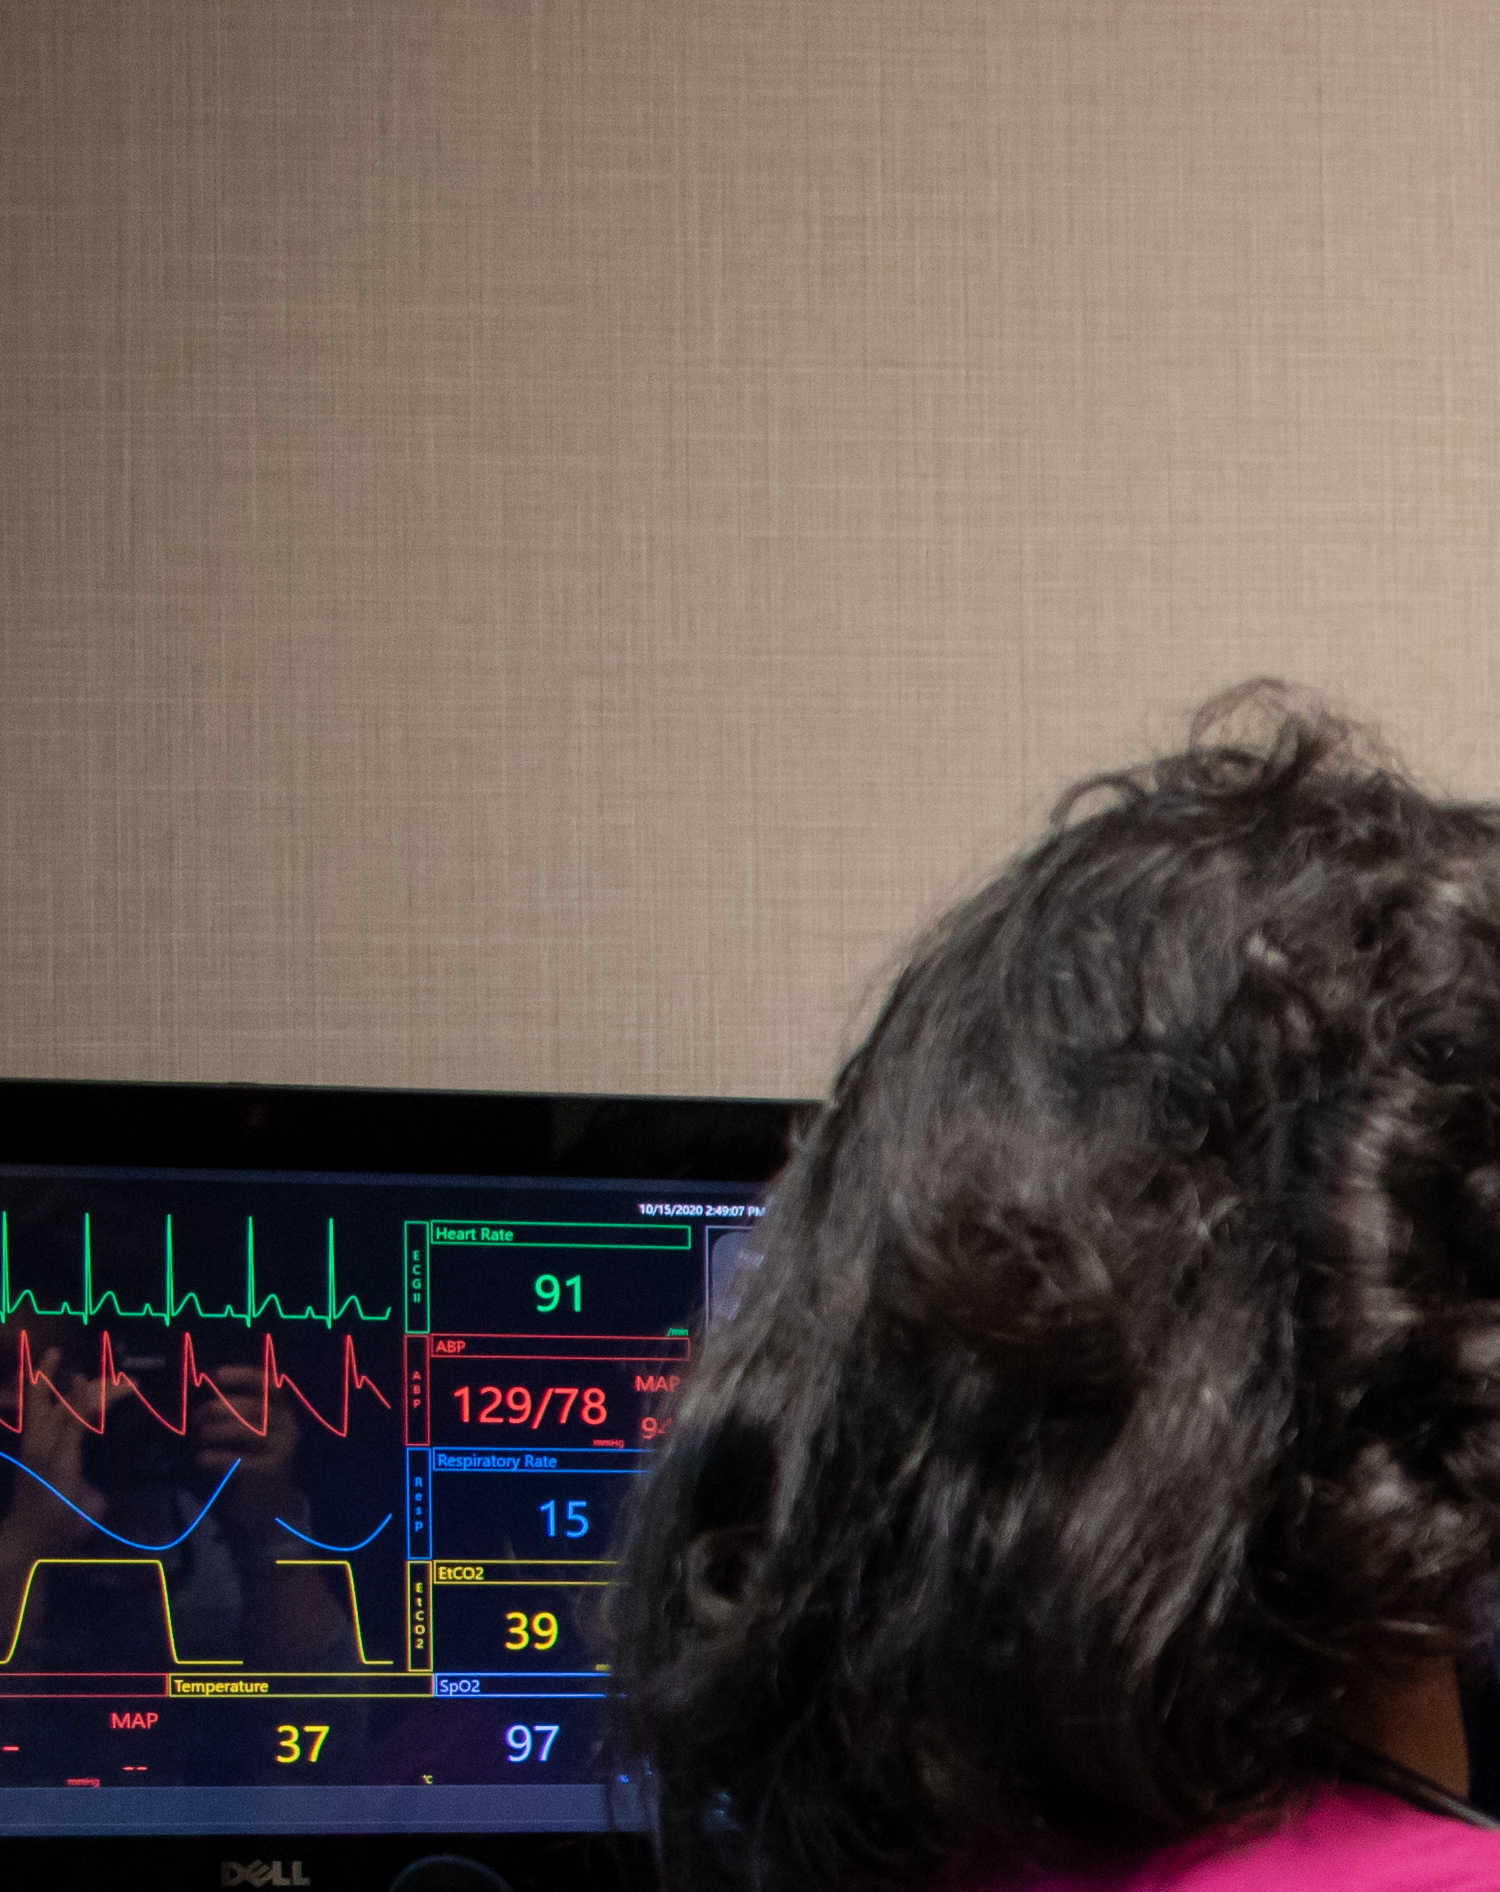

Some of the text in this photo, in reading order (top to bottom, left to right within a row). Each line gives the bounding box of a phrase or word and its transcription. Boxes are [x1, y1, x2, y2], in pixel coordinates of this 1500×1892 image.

[639, 1203, 703, 1217] 10/15/2020
[705, 1205, 745, 1217] 2:49:07
[435, 1226, 514, 1242] Heart Rate
[534, 1273, 582, 1313] 91
[435, 1339, 467, 1354] ABP
[634, 1374, 681, 1393] MAP
[453, 1385, 608, 1430] 129/78
[437, 1453, 558, 1470] Respiratory Rate
[539, 1500, 590, 1538] 15
[437, 1566, 485, 1581] EtCO2
[504, 1611, 559, 1651] 39
[174, 1679, 270, 1697] Temperature
[438, 1679, 481, 1696] SpO2
[110, 1711, 160, 1730] MAP
[276, 1724, 331, 1764] 37
[504, 1724, 560, 1763] 97
[221, 1860, 311, 1888] DELL
